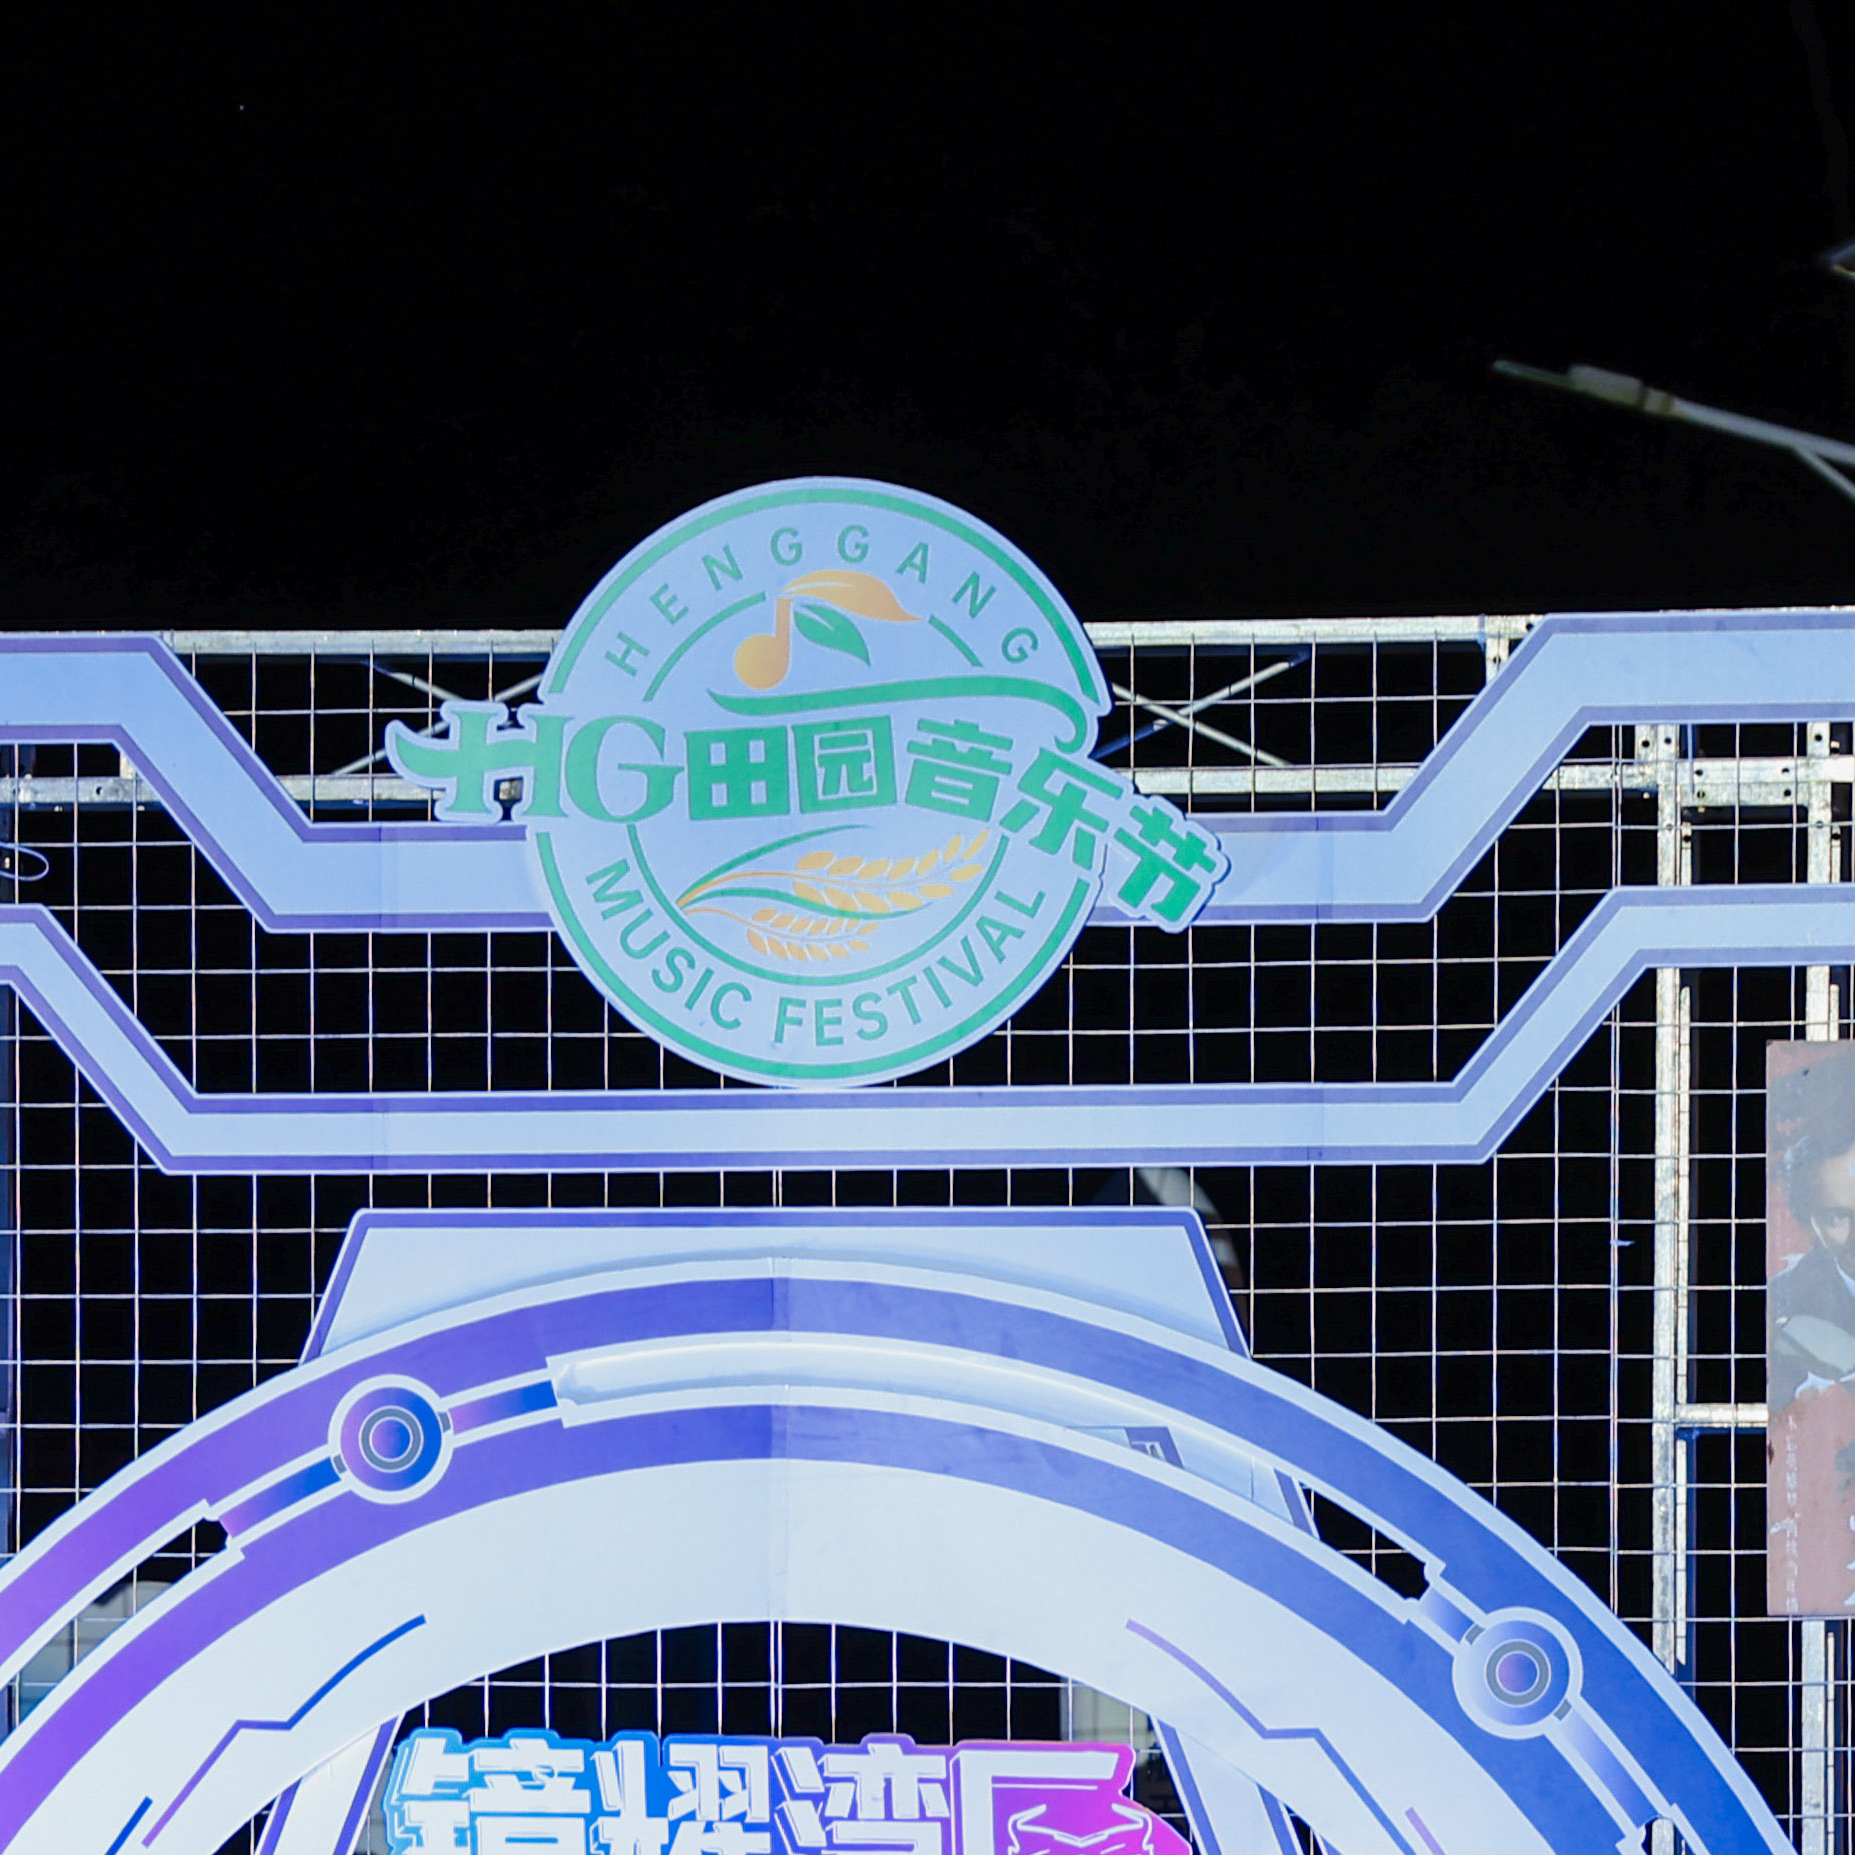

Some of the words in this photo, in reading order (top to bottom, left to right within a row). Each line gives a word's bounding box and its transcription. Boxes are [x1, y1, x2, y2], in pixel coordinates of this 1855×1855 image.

[603, 524, 1041, 679] HENGGANG
[395, 709, 1218, 922] HG田园音乐节
[585, 857, 754, 1032] MUSIC
[773, 887, 1047, 1047] FESTIVAL
